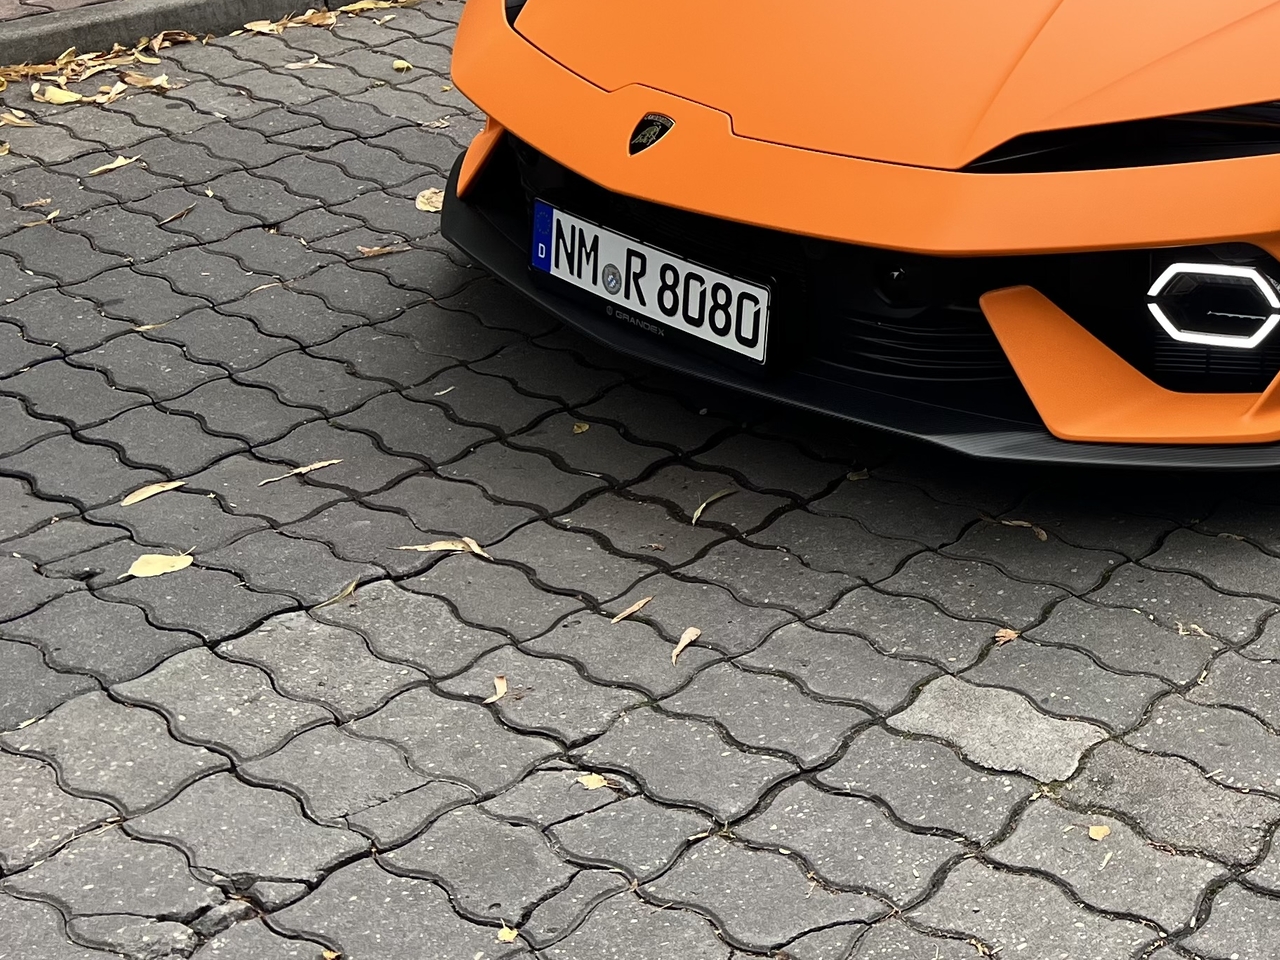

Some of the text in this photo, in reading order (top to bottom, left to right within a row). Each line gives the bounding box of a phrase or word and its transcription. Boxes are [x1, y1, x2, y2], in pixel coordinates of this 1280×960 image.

[538, 243, 546, 258] D
[554, 218, 762, 349] NM R 8080
[615, 310, 665, 337] GRANDEX
